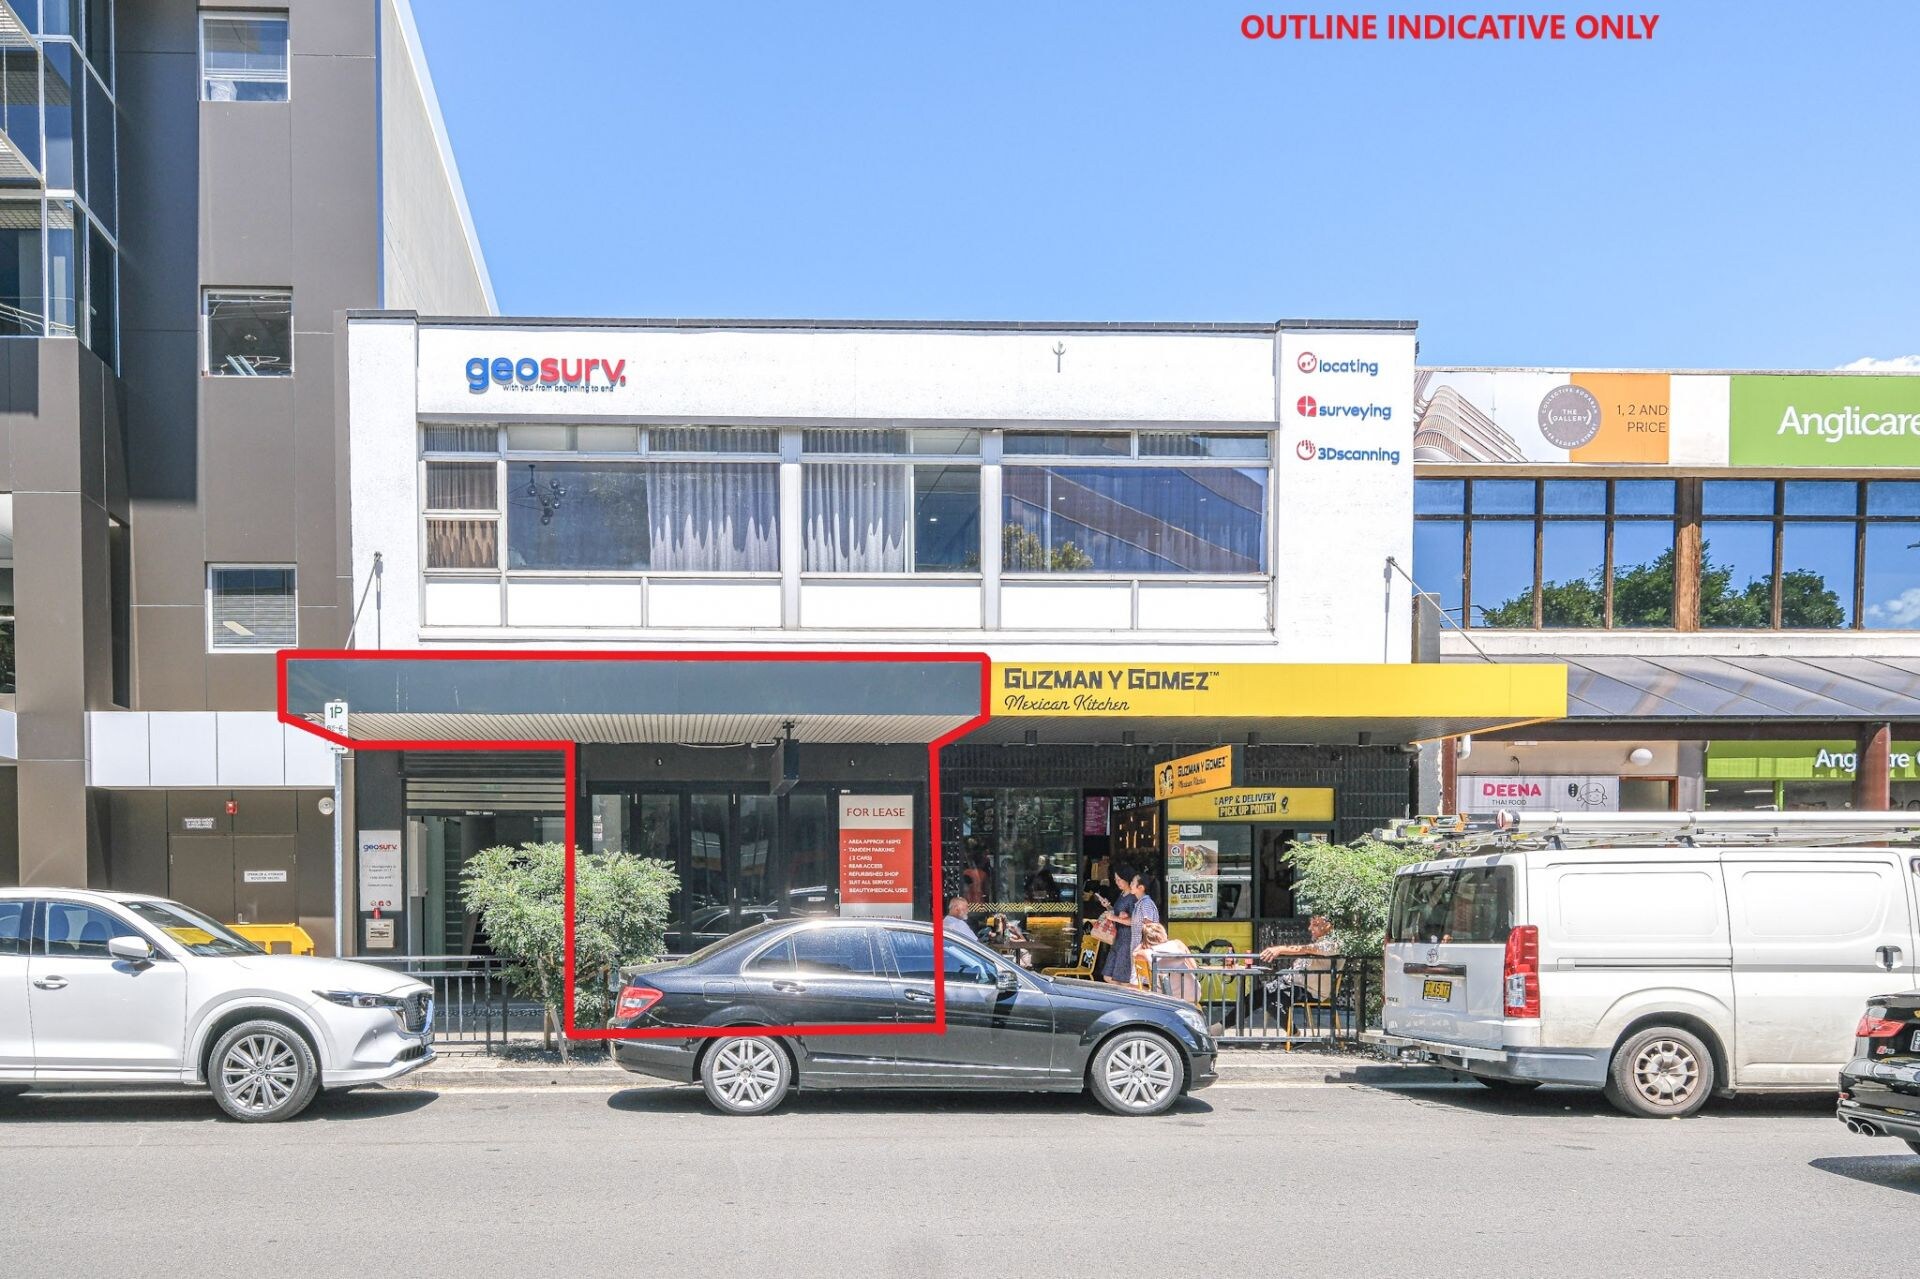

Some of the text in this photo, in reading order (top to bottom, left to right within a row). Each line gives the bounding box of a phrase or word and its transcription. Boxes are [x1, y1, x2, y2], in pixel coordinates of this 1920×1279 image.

[1319, 358, 1379, 377] locating
[520, 385, 534, 393] you
[535, 384, 552, 392] from
[554, 384, 590, 394] beginning
[591, 384, 599, 392] to
[1319, 403, 1392, 421] surveying
[1627, 404, 1636, 416] 2
[1639, 404, 1669, 417] AND
[1627, 421, 1667, 433] PRICE
[1317, 446, 1401, 465] 3Dscanning
[1004, 667, 1104, 691] GUZMAN
[1107, 669, 1124, 691] Y
[1003, 694, 1131, 712] Mexican Kitchen
[329, 705, 343, 719] 1P
[1815, 748, 1910, 773] Angre
[1177, 761, 1200, 778] GUZMAN
[1482, 783, 1542, 797] DEENA
[1241, 792, 1277, 804] DELIVERY
[846, 807, 906, 817] FOR LEASE
[1219, 803, 1277, 817] PICK UP POINT!
[1170, 883, 1214, 895] CAESAR
